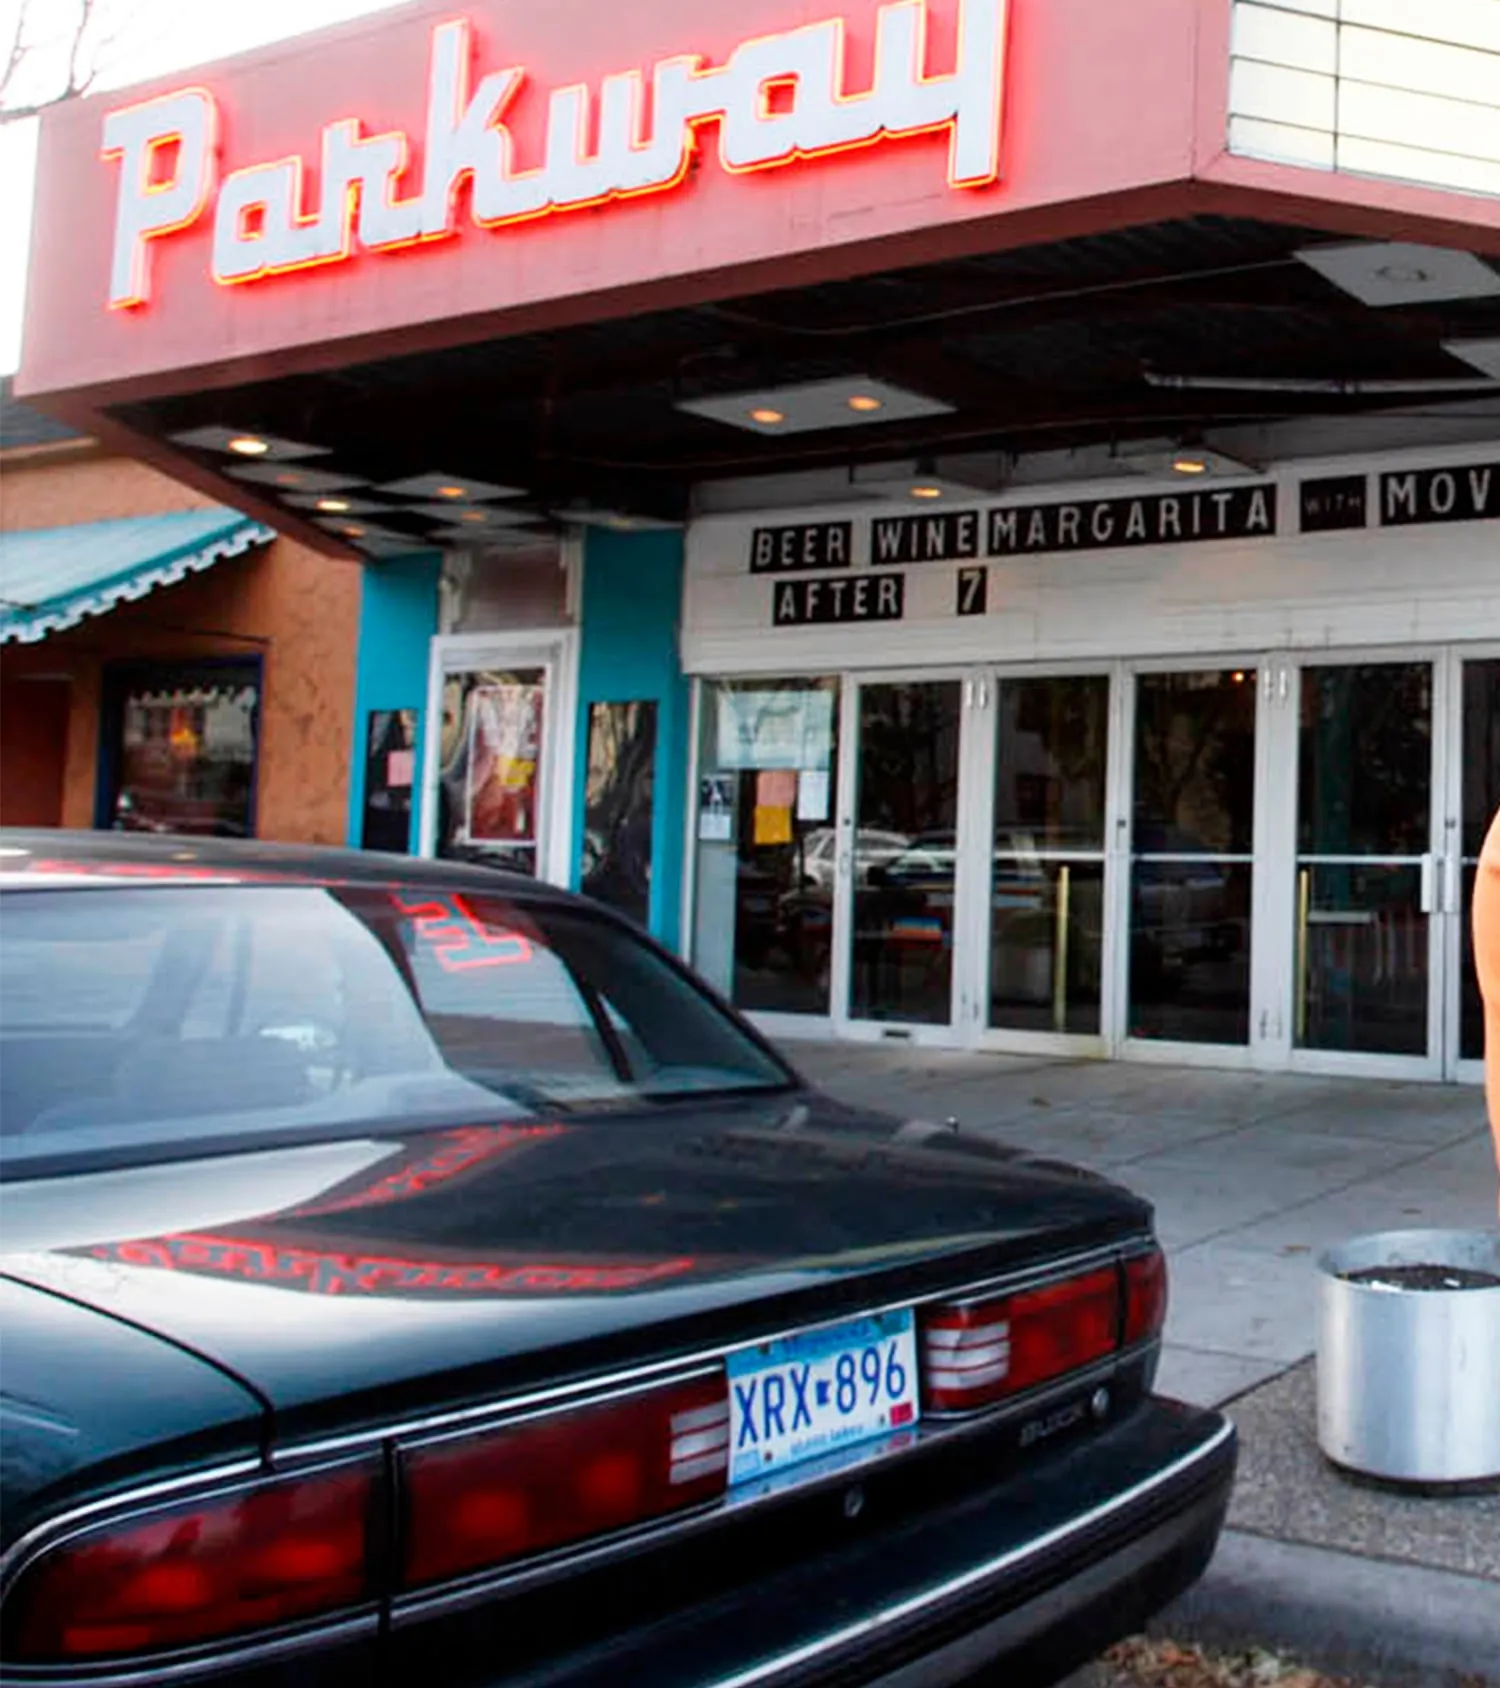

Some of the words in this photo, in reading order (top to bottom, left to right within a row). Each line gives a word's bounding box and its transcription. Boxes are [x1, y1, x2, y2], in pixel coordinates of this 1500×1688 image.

[99, 0, 1003, 310] Parkway
[754, 526, 846, 567] BEER
[877, 514, 974, 560] WINE
[991, 488, 1269, 550] MARGARITA
[1304, 493, 1362, 516] WITH
[778, 577, 898, 620] AFTER
[960, 569, 983, 612] 7
